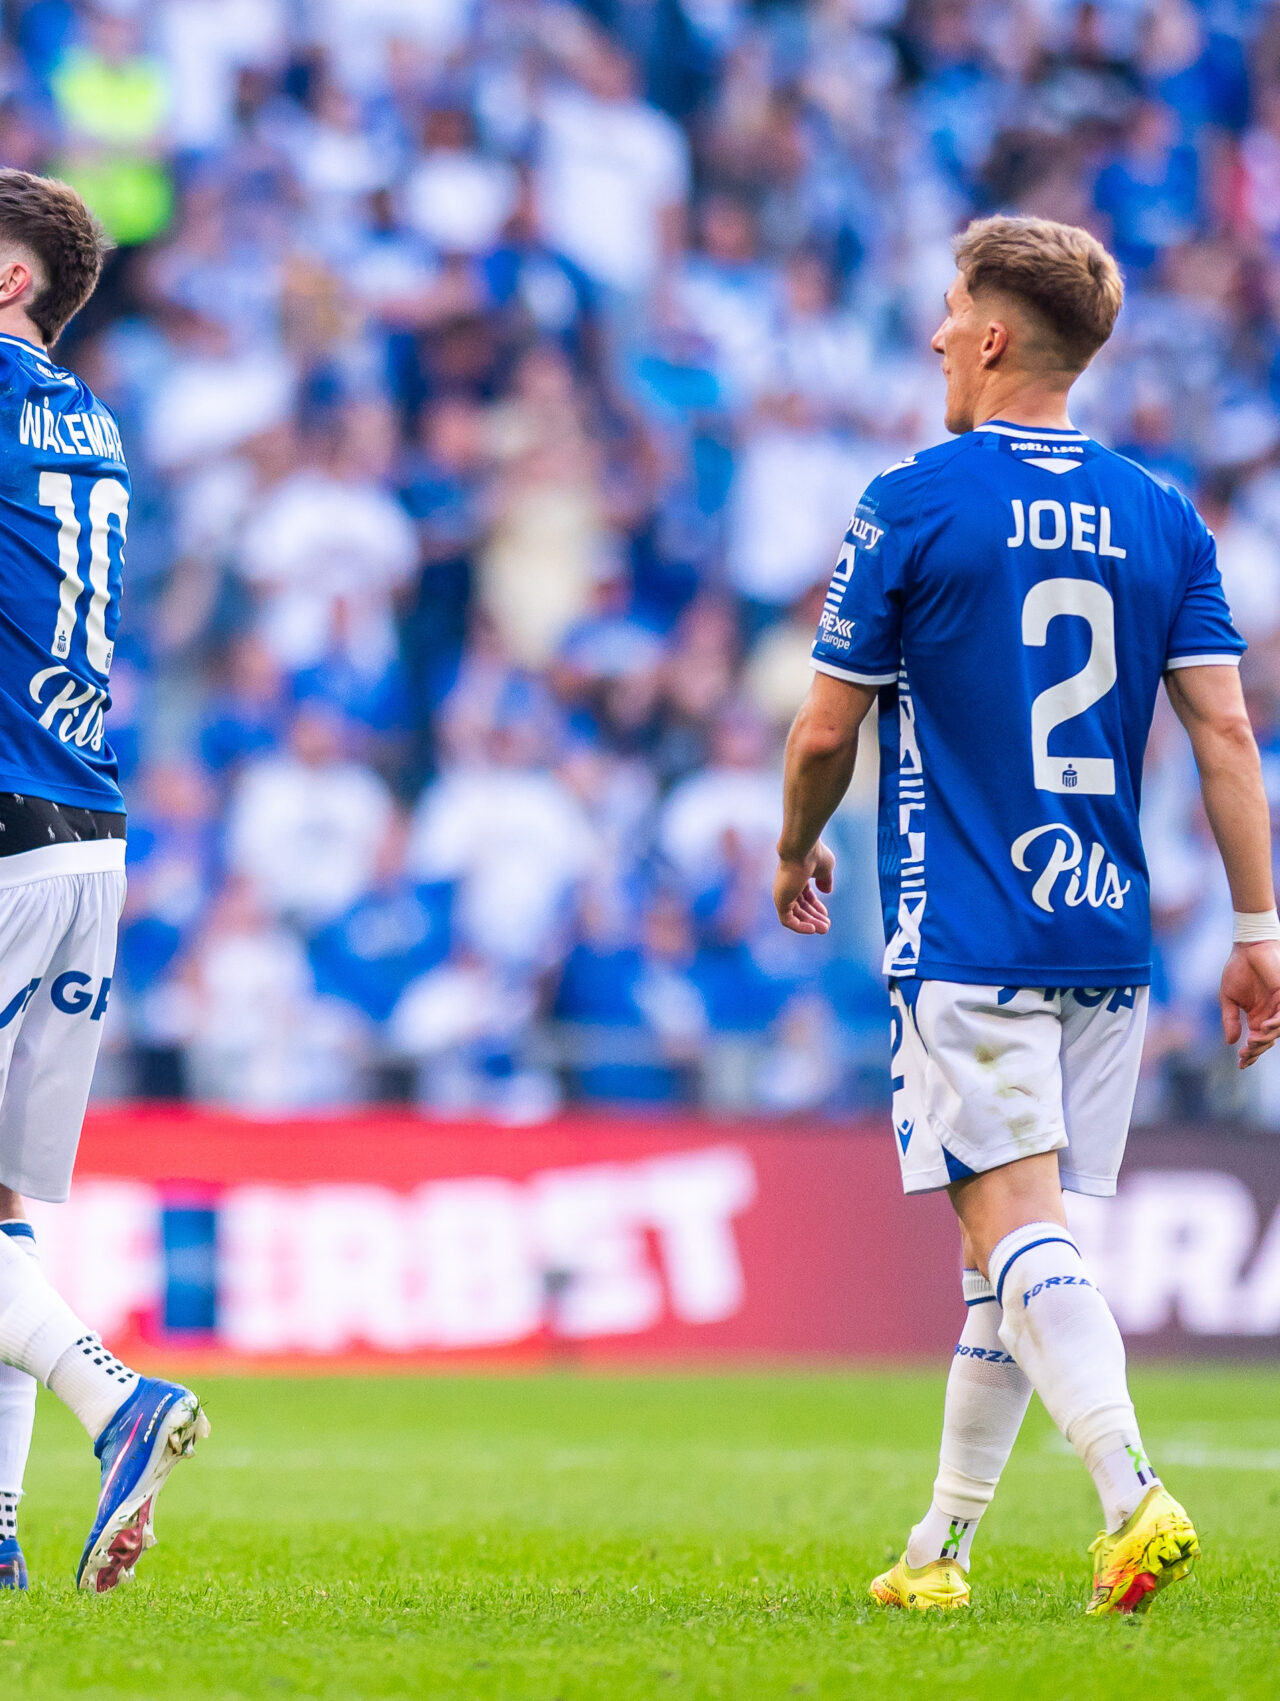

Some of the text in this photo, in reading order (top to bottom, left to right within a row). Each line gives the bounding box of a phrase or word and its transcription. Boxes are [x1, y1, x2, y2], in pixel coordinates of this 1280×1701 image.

[1010, 442, 1051, 453] FORZA
[1007, 499, 1127, 560] JOEL
[38, 471, 130, 675] 10
[822, 630, 851, 651] Europe
[1021, 577, 1118, 795] 2
[1010, 823, 1131, 912] Pils
